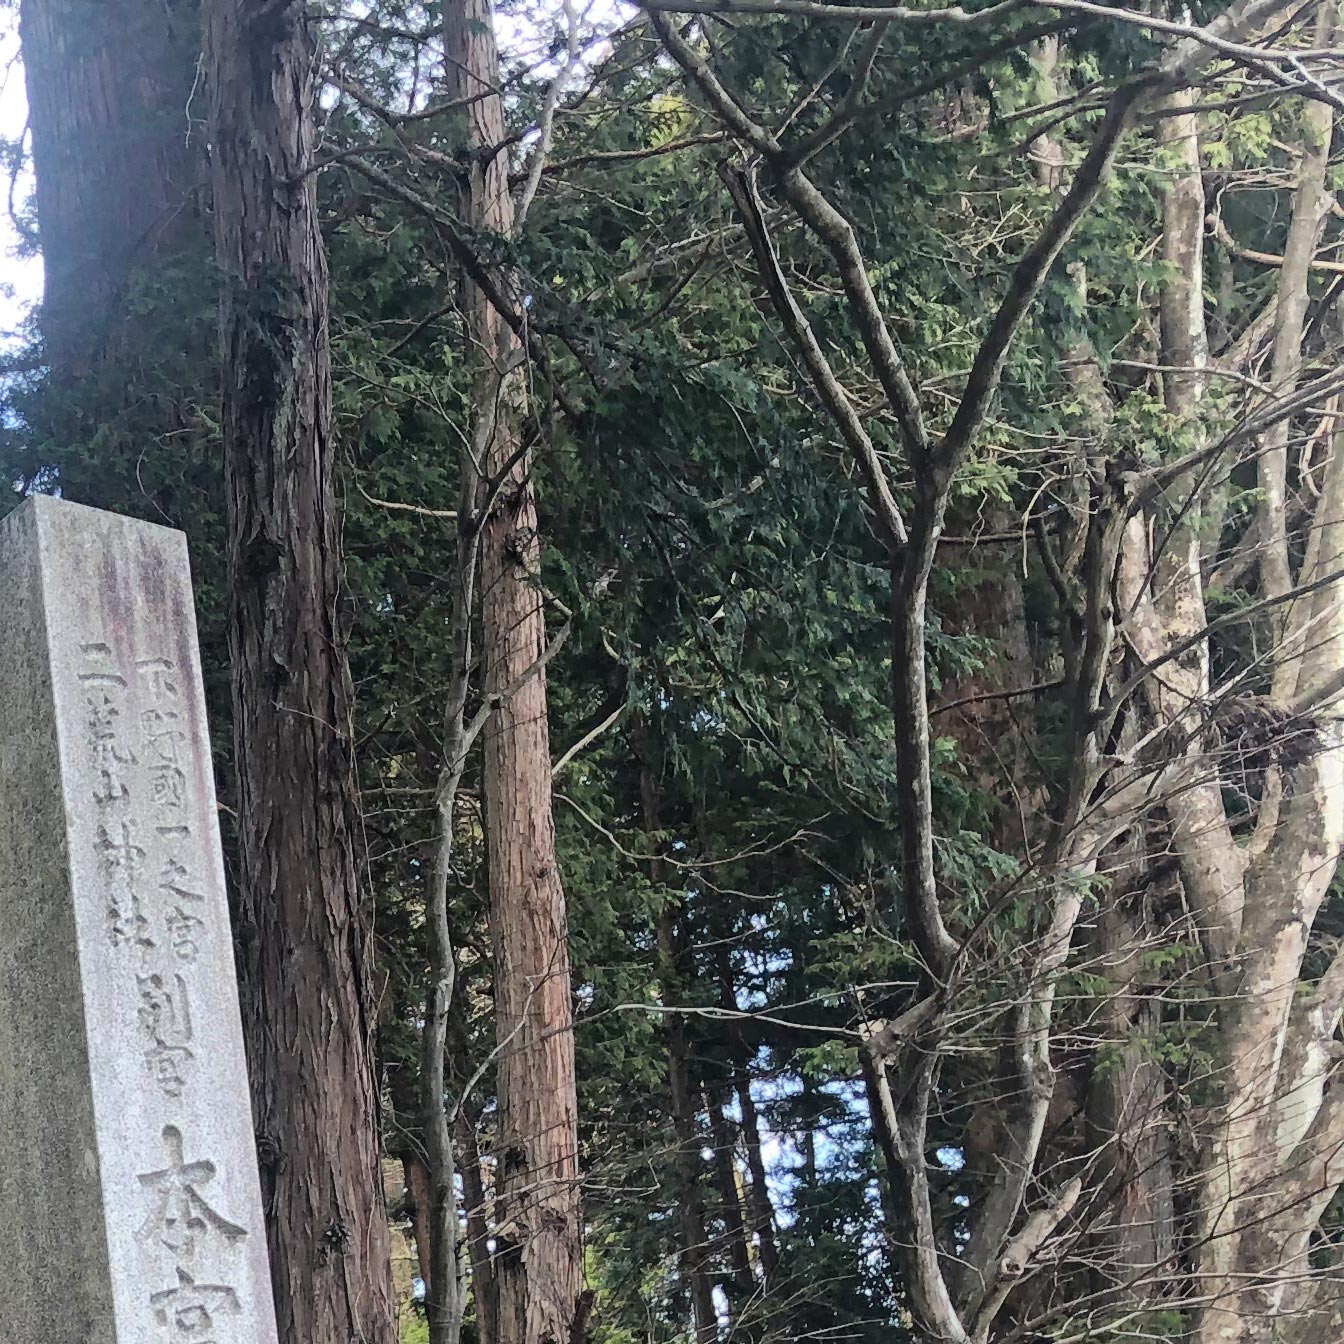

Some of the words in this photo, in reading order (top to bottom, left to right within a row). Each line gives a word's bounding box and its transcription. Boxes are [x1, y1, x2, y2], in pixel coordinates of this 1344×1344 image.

[78, 642, 157, 955] 二荒山神社
